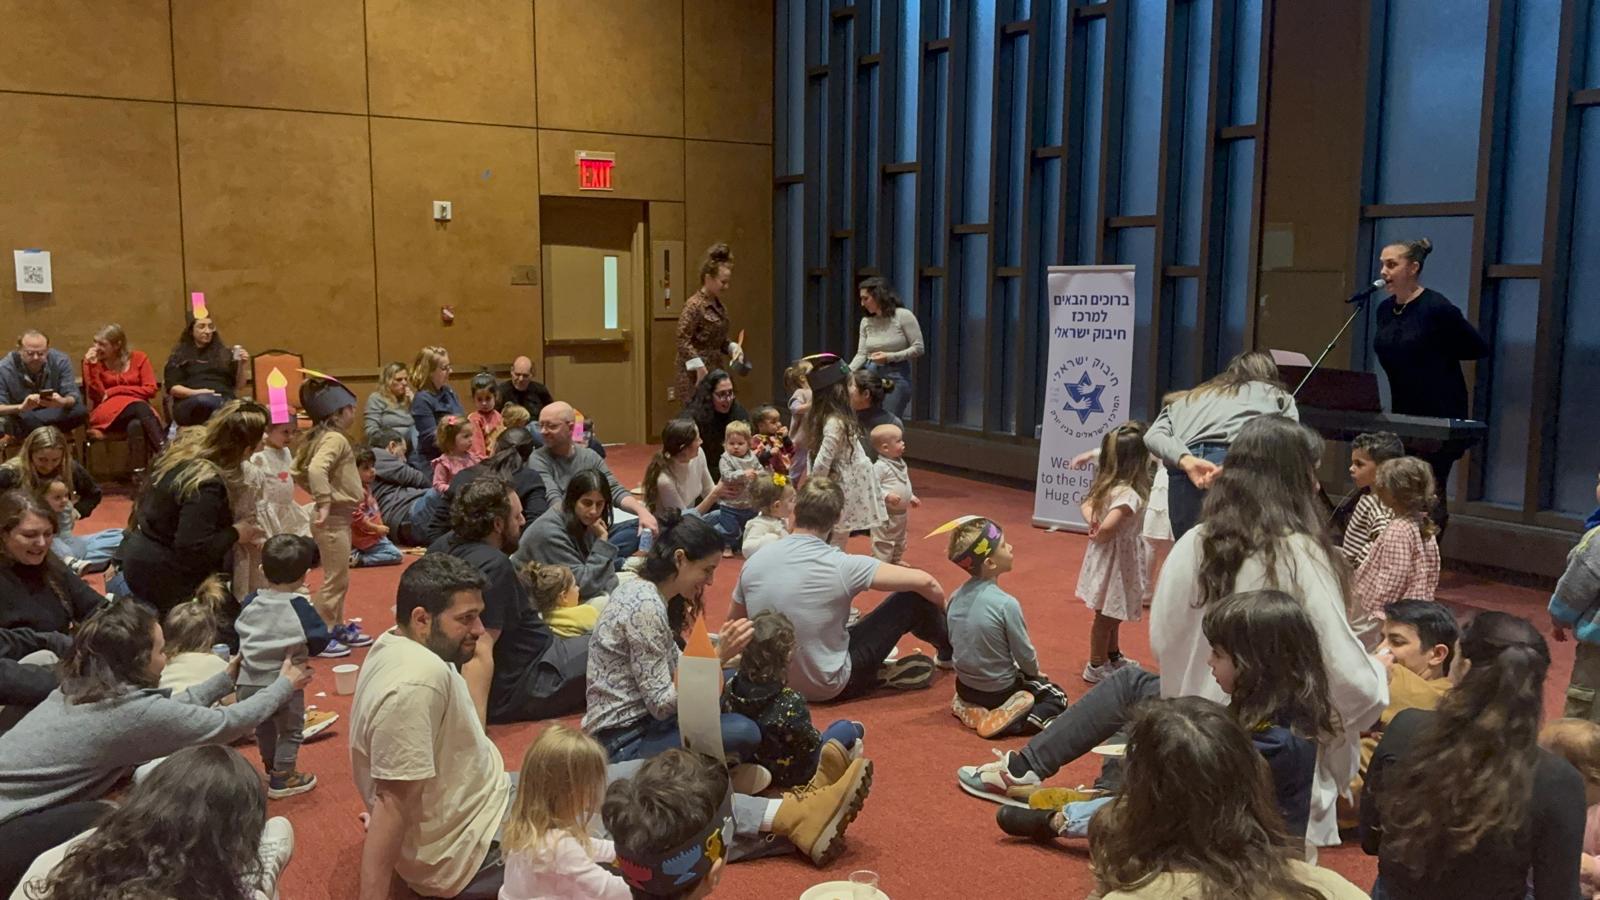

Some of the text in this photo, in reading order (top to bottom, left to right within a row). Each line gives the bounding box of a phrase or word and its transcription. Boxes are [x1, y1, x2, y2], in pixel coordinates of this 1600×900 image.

[582, 160, 611, 187] EXIT
[1053, 295, 1130, 306] ברוכים הבאים
[1071, 310, 1108, 323] למרכז
[1054, 326, 1127, 342] חיבוק ישראלי
[1053, 356, 1119, 387] חיבוק ישראלי
[1041, 472, 1053, 484] to
[1056, 473, 1076, 486] the
[1045, 488, 1069, 505] Hug
